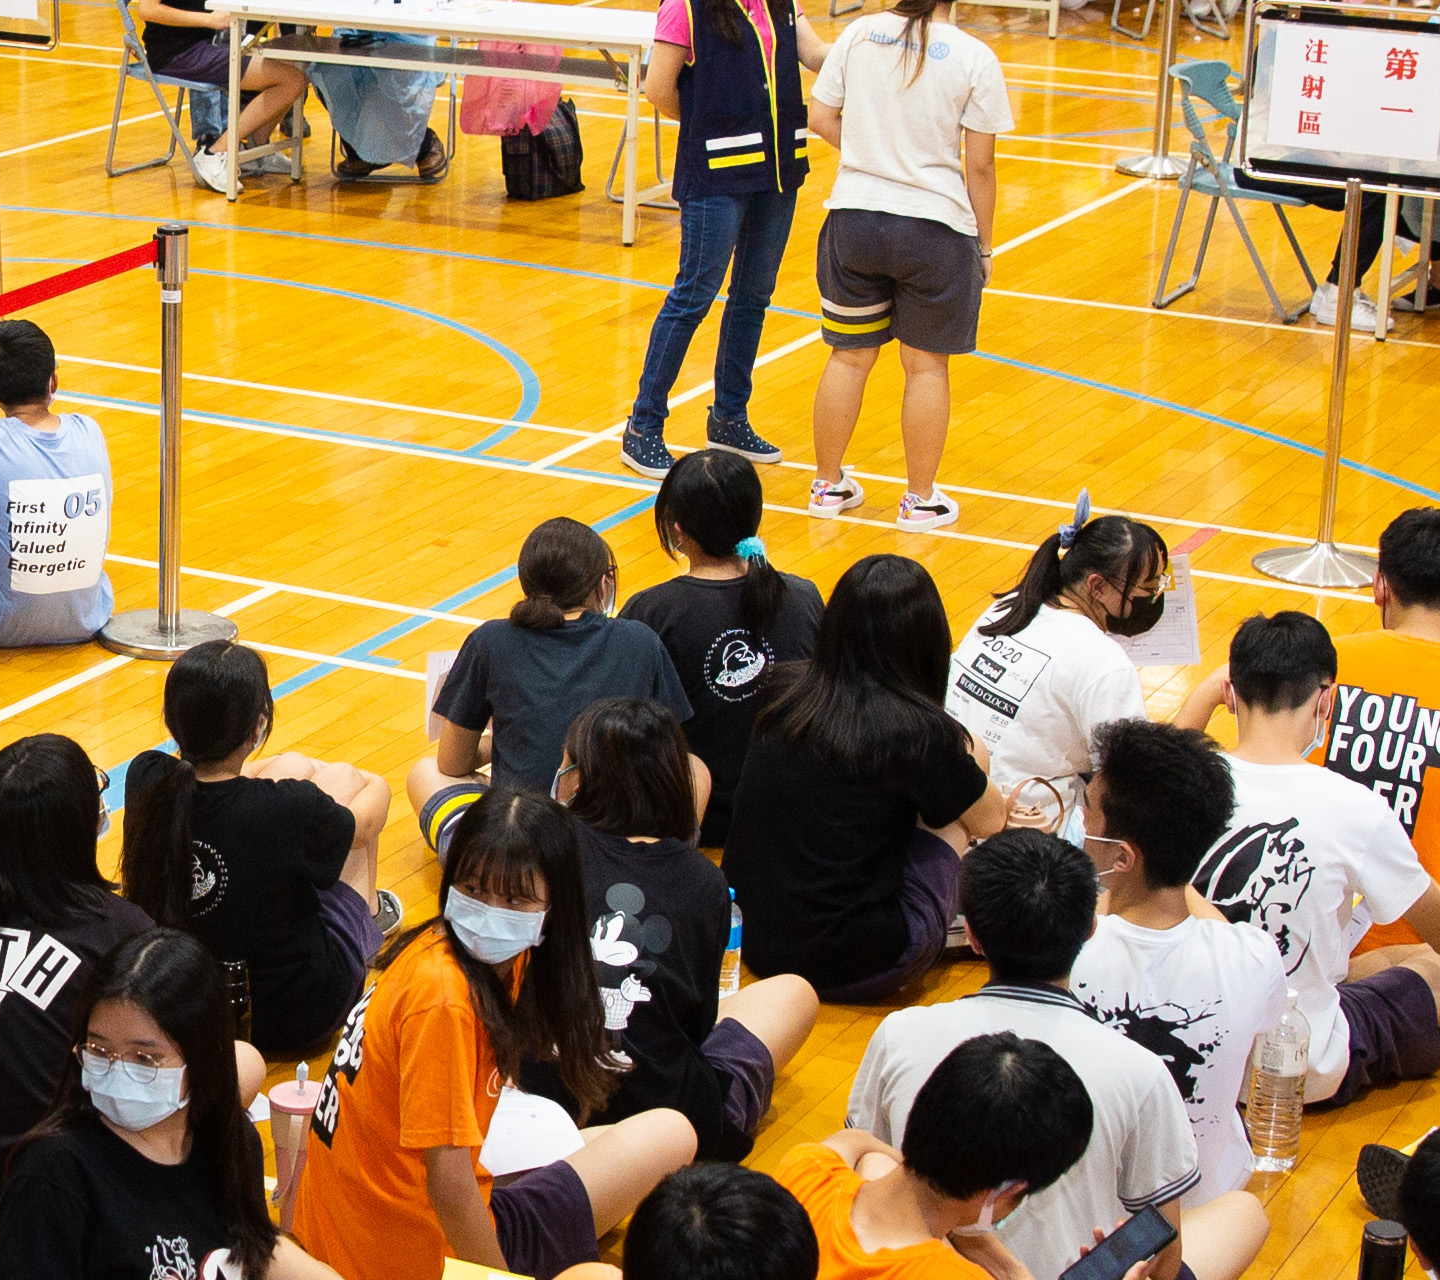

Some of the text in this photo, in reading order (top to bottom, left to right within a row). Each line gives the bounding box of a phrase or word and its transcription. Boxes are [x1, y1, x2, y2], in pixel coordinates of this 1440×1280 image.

[1298, 39, 1328, 135] 注射區
[1380, 47, 1419, 113] 第一
[7, 501, 46, 514] First
[63, 488, 102, 520] 05
[8, 521, 68, 536] Infinity
[9, 540, 66, 554] Valued
[8, 557, 86, 577] Energetic
[982, 634, 1023, 665] 20:20
[974, 655, 1005, 682] Taipei
[959, 675, 1016, 717] WORLD CLOCKS
[1328, 724, 1427, 783] FOUR
[1373, 779, 1418, 825] ER
